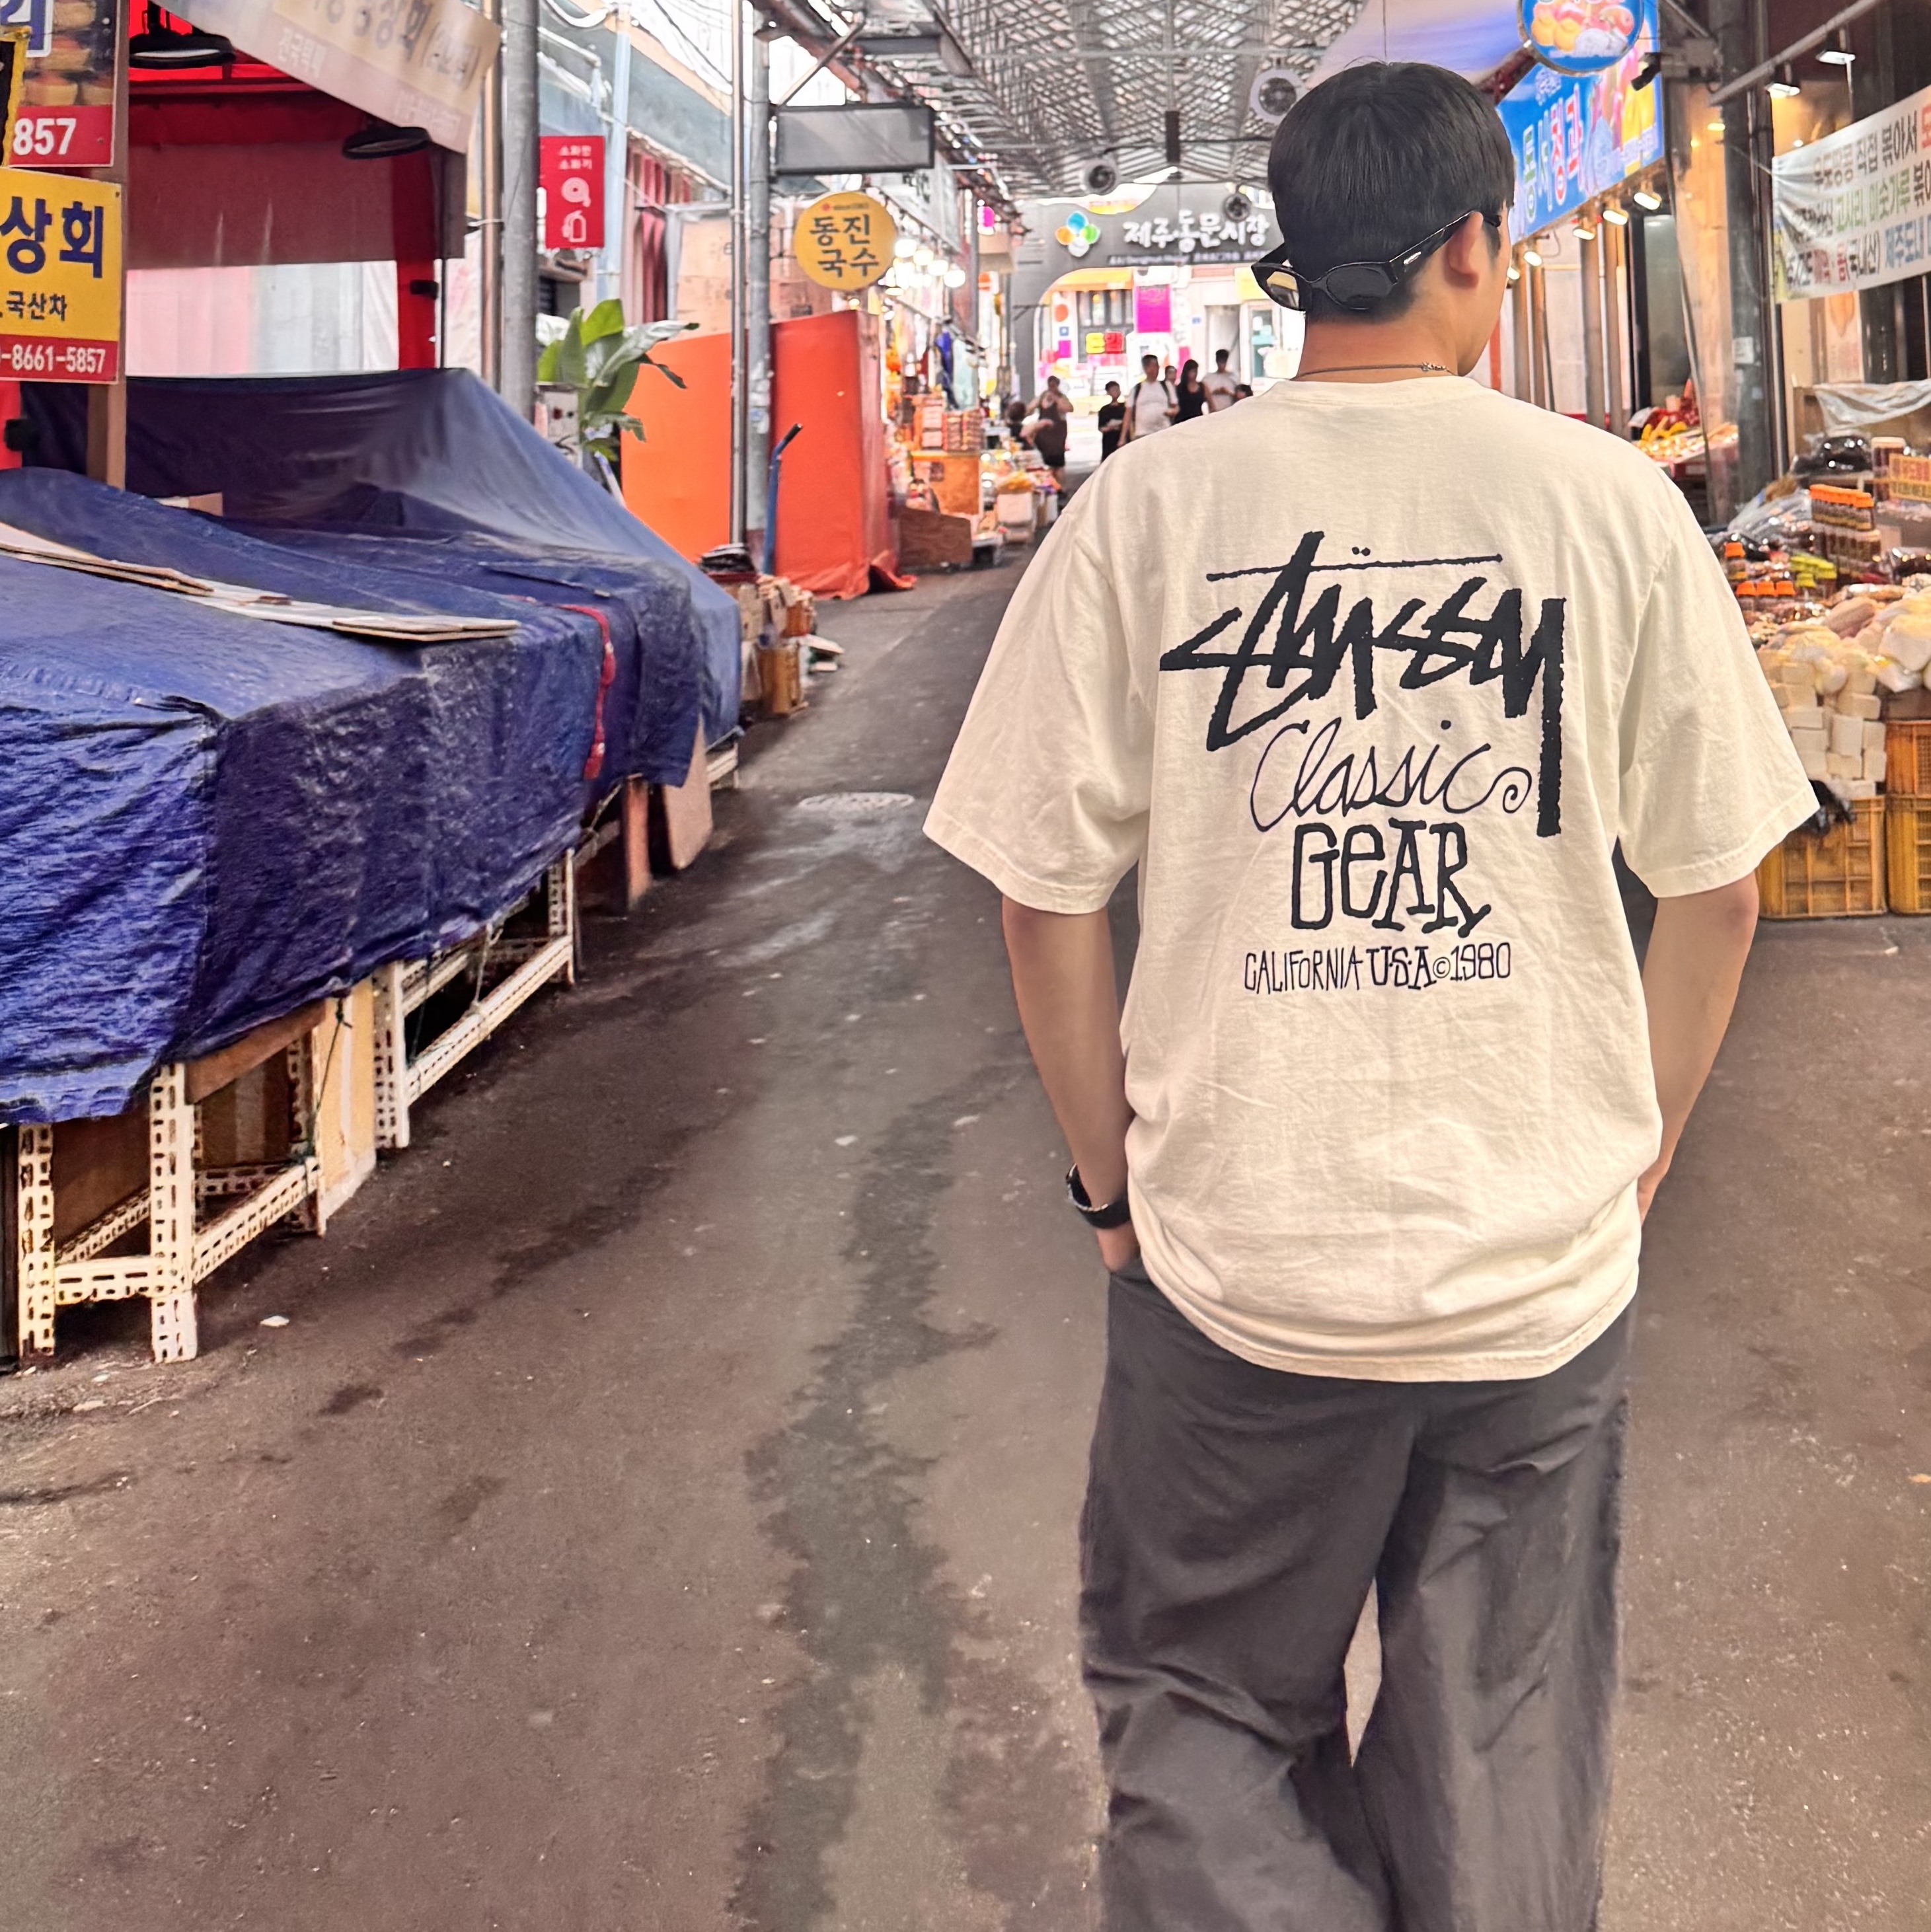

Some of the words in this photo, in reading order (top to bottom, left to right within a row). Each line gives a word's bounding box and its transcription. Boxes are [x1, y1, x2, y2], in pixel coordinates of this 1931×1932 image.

[13, 118, 77, 155] 857
[1882, 110, 1917, 167] 볶아서
[0, 196, 104, 278] 상회
[809, 213, 870, 246] 동진
[817, 248, 880, 278] 국수
[1250, 716, 1533, 832] Classic
[1244, 946, 1363, 994] CALIFORNIA
